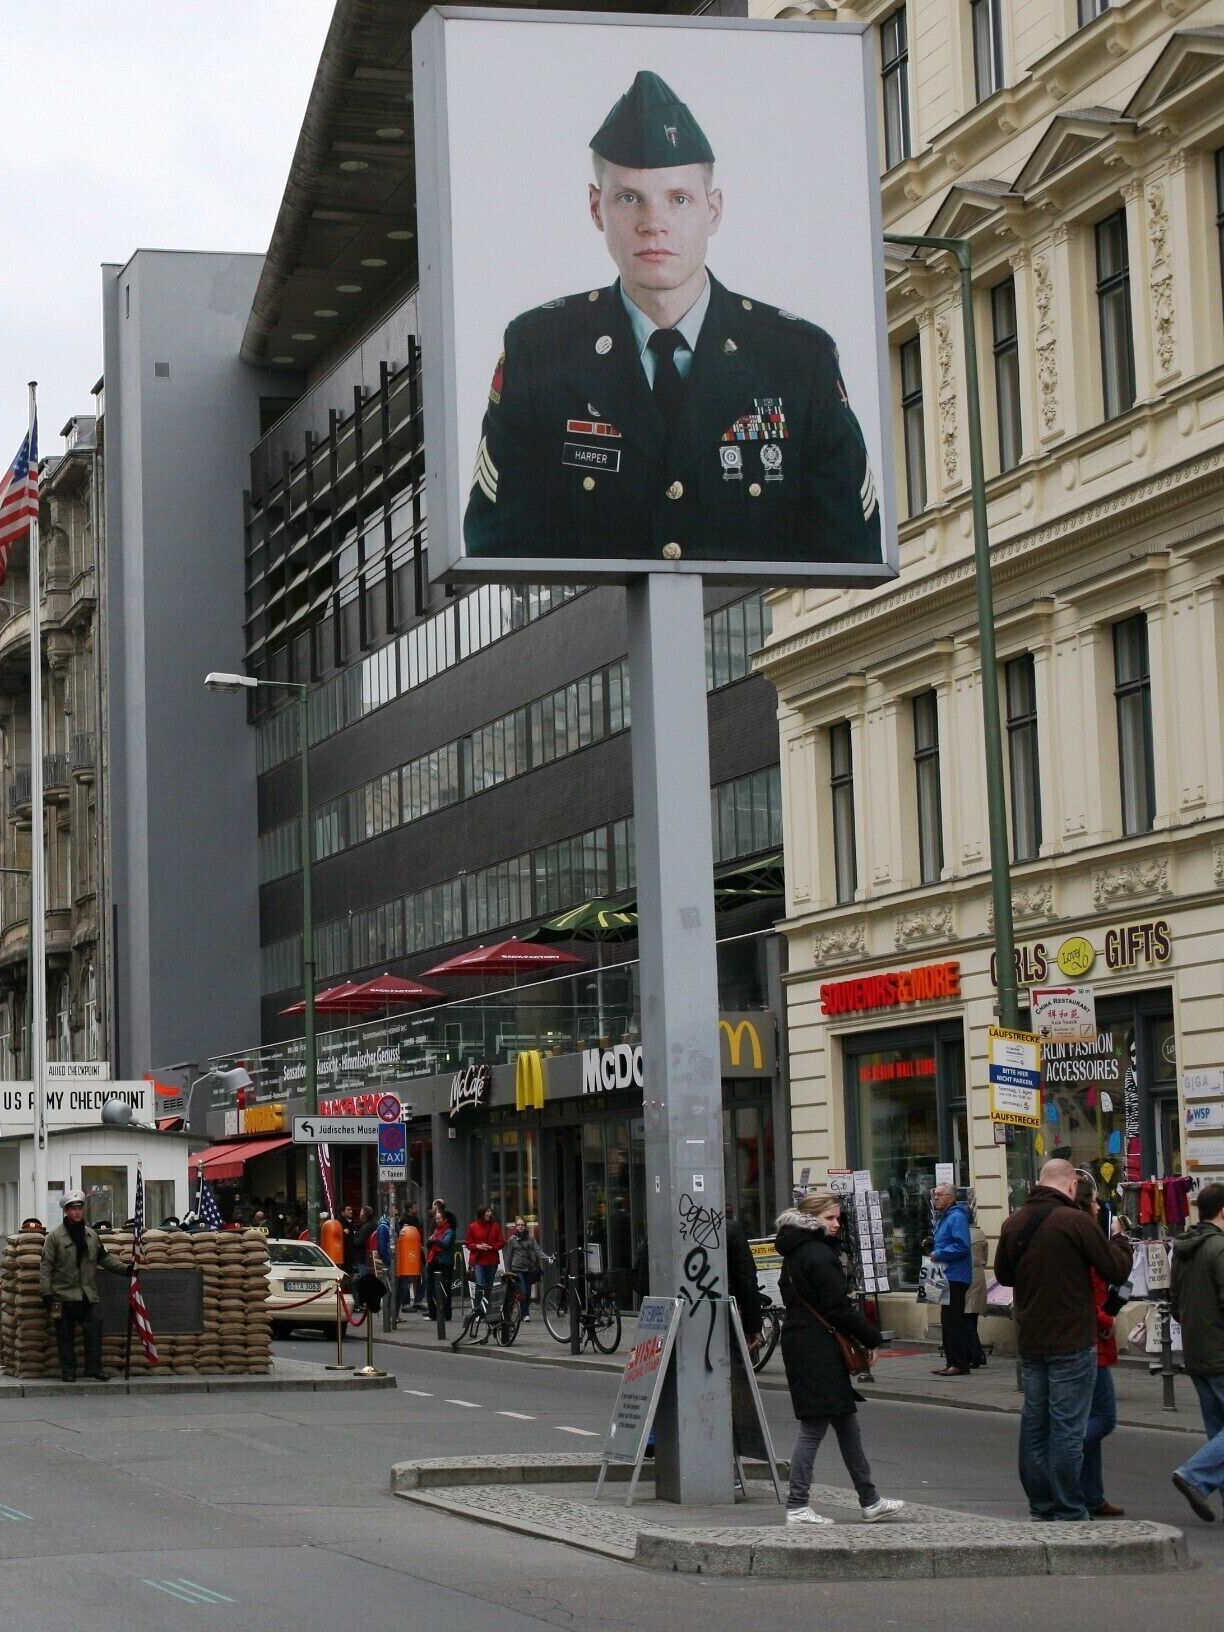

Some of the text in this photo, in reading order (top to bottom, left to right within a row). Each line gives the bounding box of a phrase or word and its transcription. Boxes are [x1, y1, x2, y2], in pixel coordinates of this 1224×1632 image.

[574, 450, 608, 464] HARPER
[1105, 921, 1170, 969] GIFTS
[989, 1028, 1041, 1044] LAUFSTRECKE
[1069, 1033, 1113, 1057] FASHION
[377, 1043, 401, 1063] Genuss!
[48, 1065, 100, 1076] ALLIED CHECKPOINT
[1002, 1067, 1016, 1076] BITTE
[1046, 1059, 1119, 1082] ACCESSOIRES
[996, 1074, 1013, 1083] NICHT
[3, 1091, 22, 1110] US
[28, 1091, 64, 1110] AMY
[990, 1111, 1040, 1126] LAUFSTRECKE
[1193, 1107, 1211, 1119] WSP
[318, 1124, 379, 1135] Jüdisches Muse
